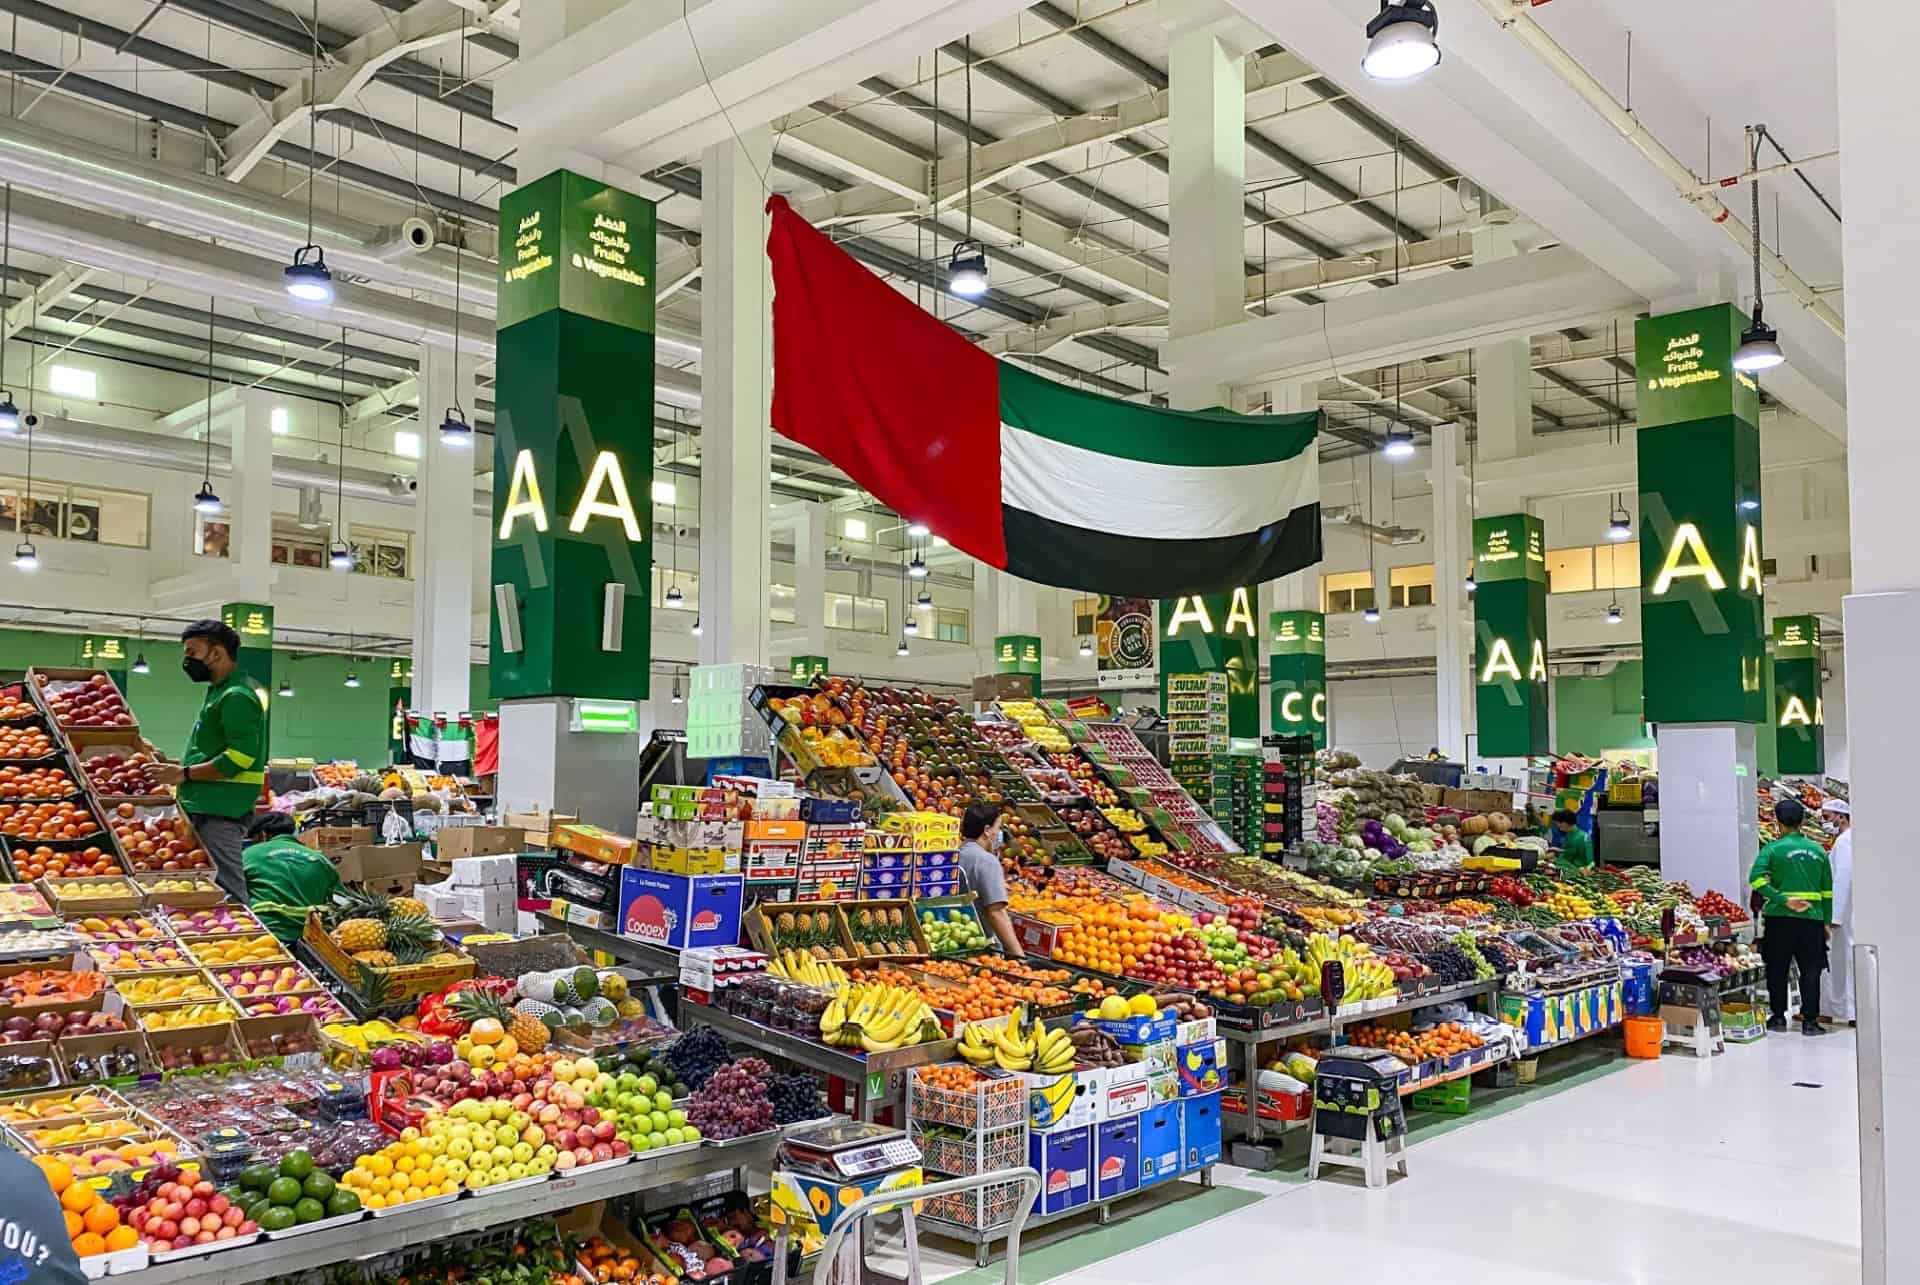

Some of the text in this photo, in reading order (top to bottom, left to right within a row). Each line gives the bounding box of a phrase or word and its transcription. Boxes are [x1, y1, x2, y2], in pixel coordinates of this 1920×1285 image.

[572, 253, 646, 287] & Vegetables
[593, 245, 625, 265] Fruits
[1659, 370, 1721, 388] Vegetables
[1667, 360, 1698, 374] Fruits
[499, 449, 549, 540] A
[569, 450, 643, 542] A
[1652, 522, 1727, 595] A
[1740, 525, 1763, 595] A
[1167, 595, 1213, 636] A
[1225, 587, 1256, 637] A
[1482, 638, 1522, 682] A
[1529, 639, 1547, 682] A
[1175, 680, 1207, 691] SULTAN
[1175, 700, 1207, 711] SULTAN
[1281, 691, 1303, 722] C
[1311, 693, 1325, 722] C
[1780, 695, 1811, 726] A
[1175, 720, 1207, 732] SULTA
[1175, 741, 1207, 753] SULTAN
[870, 1077, 881, 1094] V
